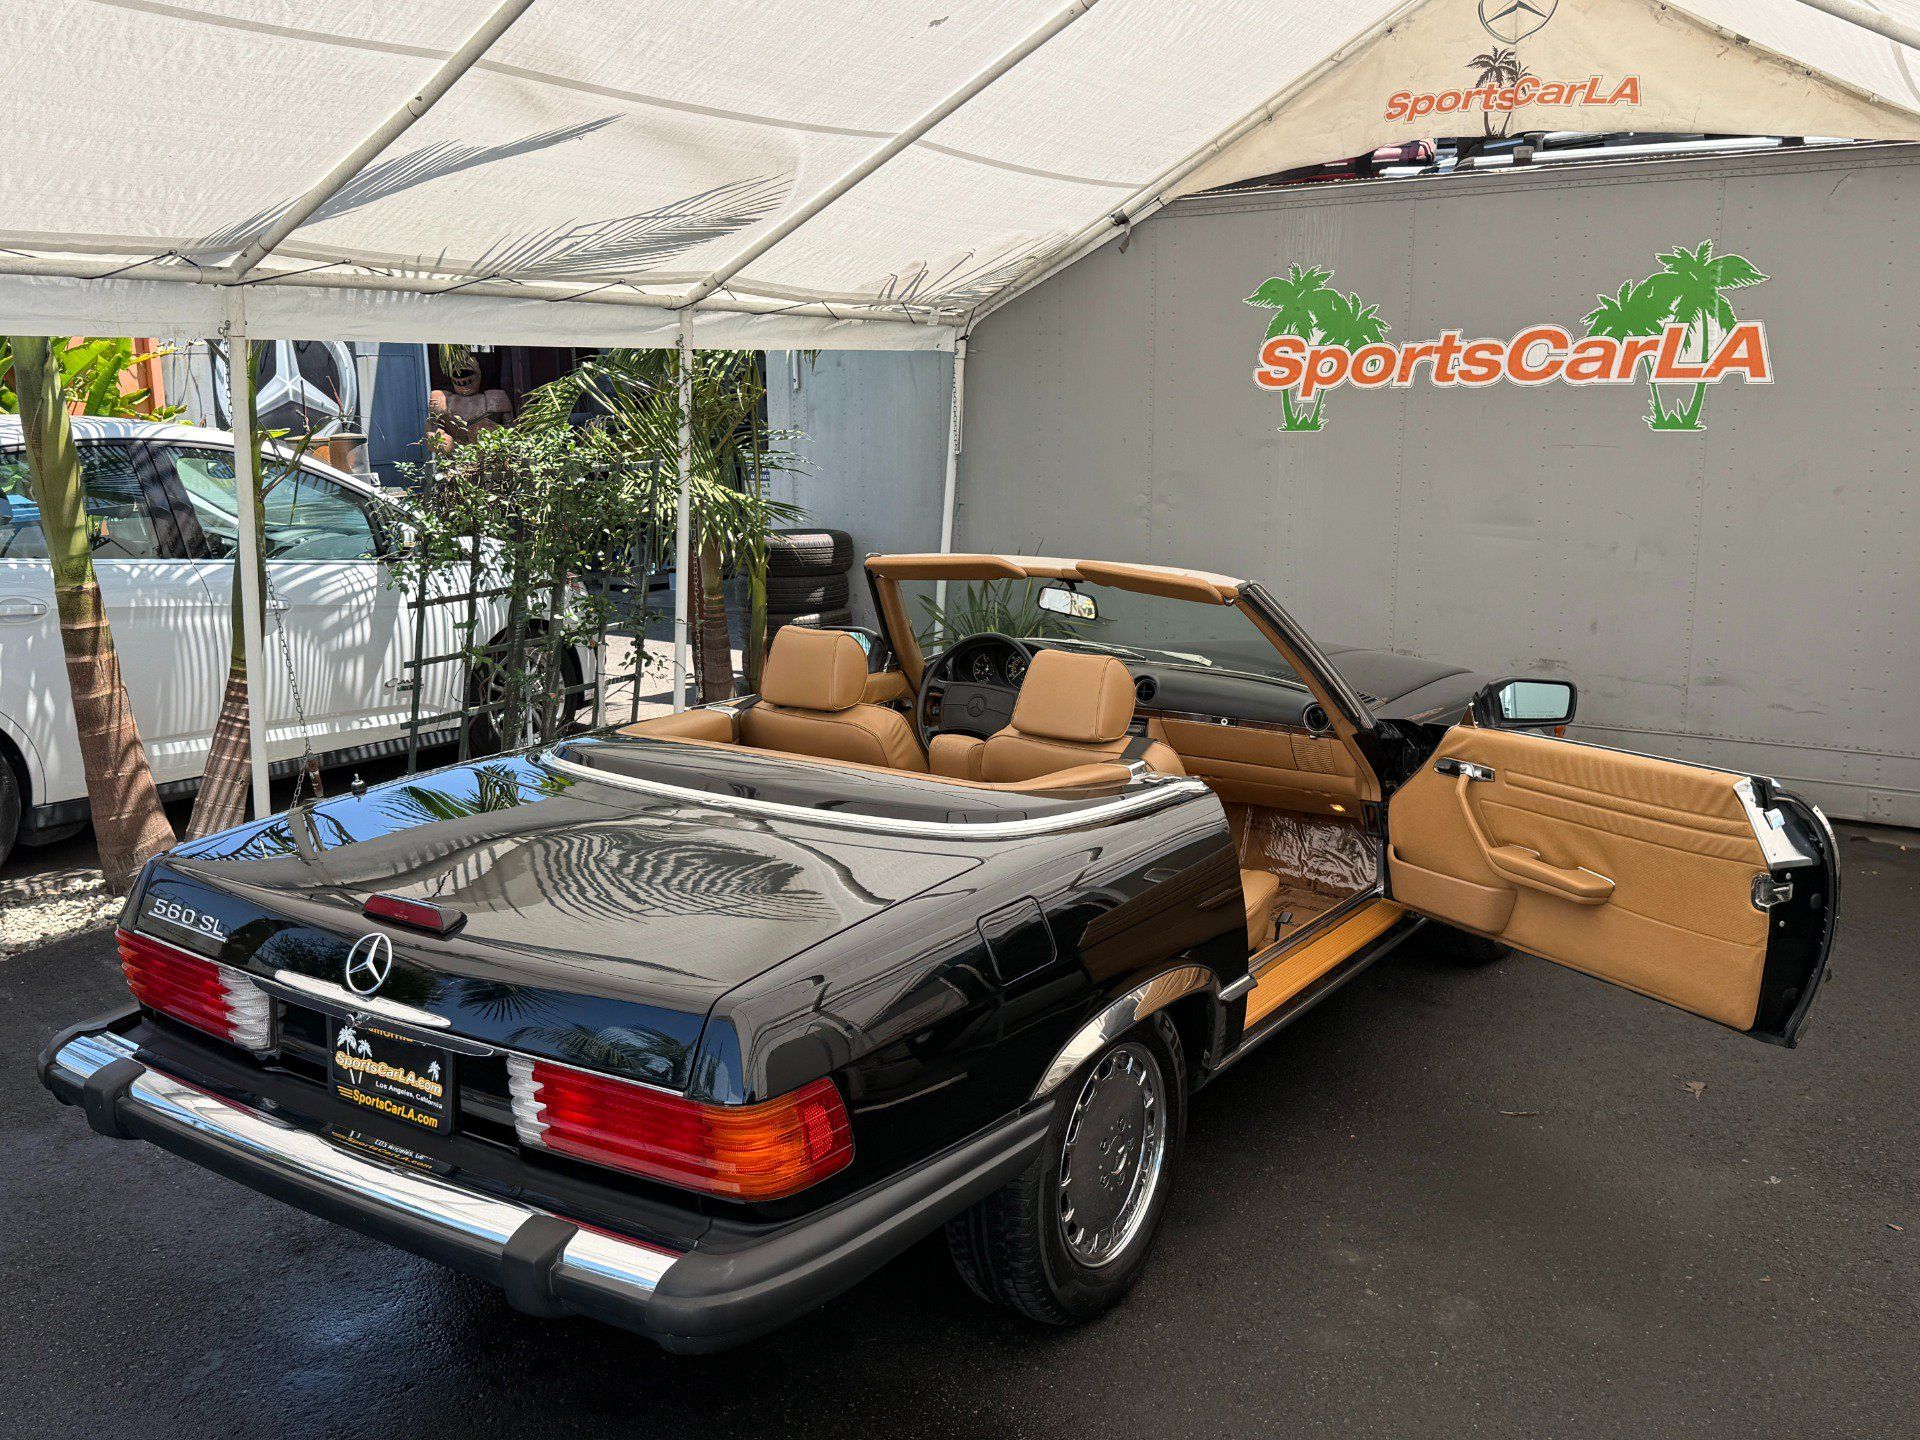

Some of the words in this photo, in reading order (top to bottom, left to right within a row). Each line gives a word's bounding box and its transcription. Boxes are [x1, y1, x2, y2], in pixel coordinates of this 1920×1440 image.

[1384, 75, 1641, 123] SportsCarLA
[1255, 320, 1772, 402] SportsCarLA
[153, 898, 196, 925] 560
[199, 915, 224, 937] SL
[335, 1051, 443, 1098] SportsCarLA.com
[375, 1080, 388, 1090] Los
[388, 1084, 415, 1100] Angeles,
[415, 1093, 443, 1110] California
[353, 1088, 439, 1129] SportsCarLA.com
